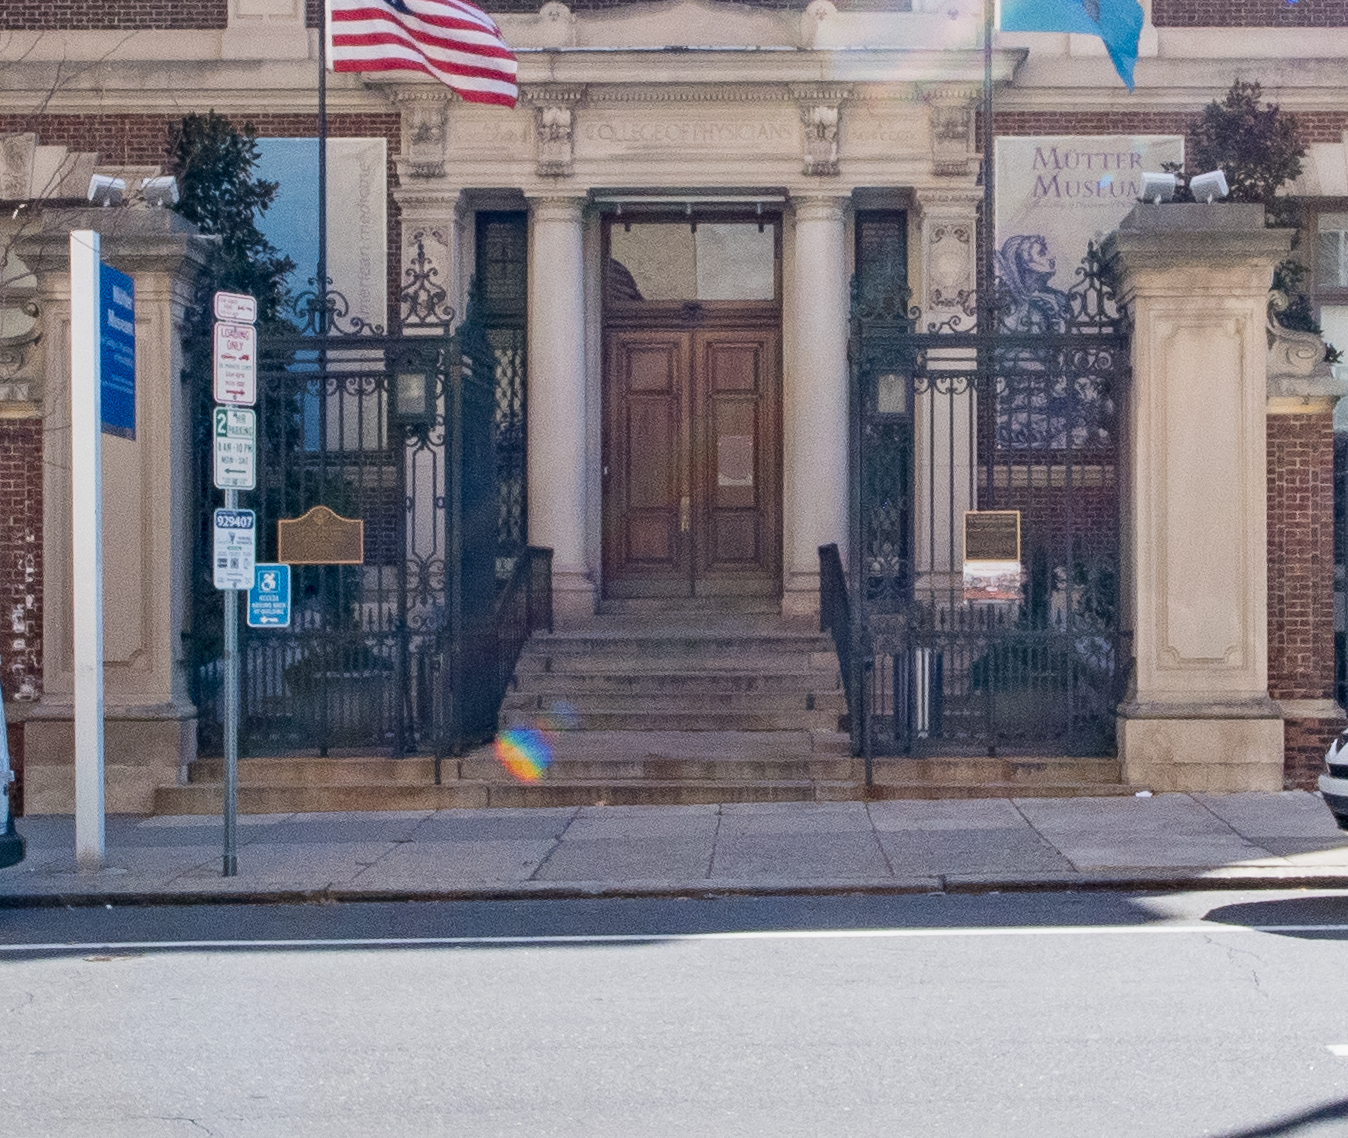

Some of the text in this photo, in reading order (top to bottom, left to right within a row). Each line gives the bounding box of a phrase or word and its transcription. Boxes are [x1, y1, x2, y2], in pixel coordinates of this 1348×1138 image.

[227, 340, 243, 351] ONLY
[217, 413, 226, 434] 2
[217, 515, 253, 528] 929407
